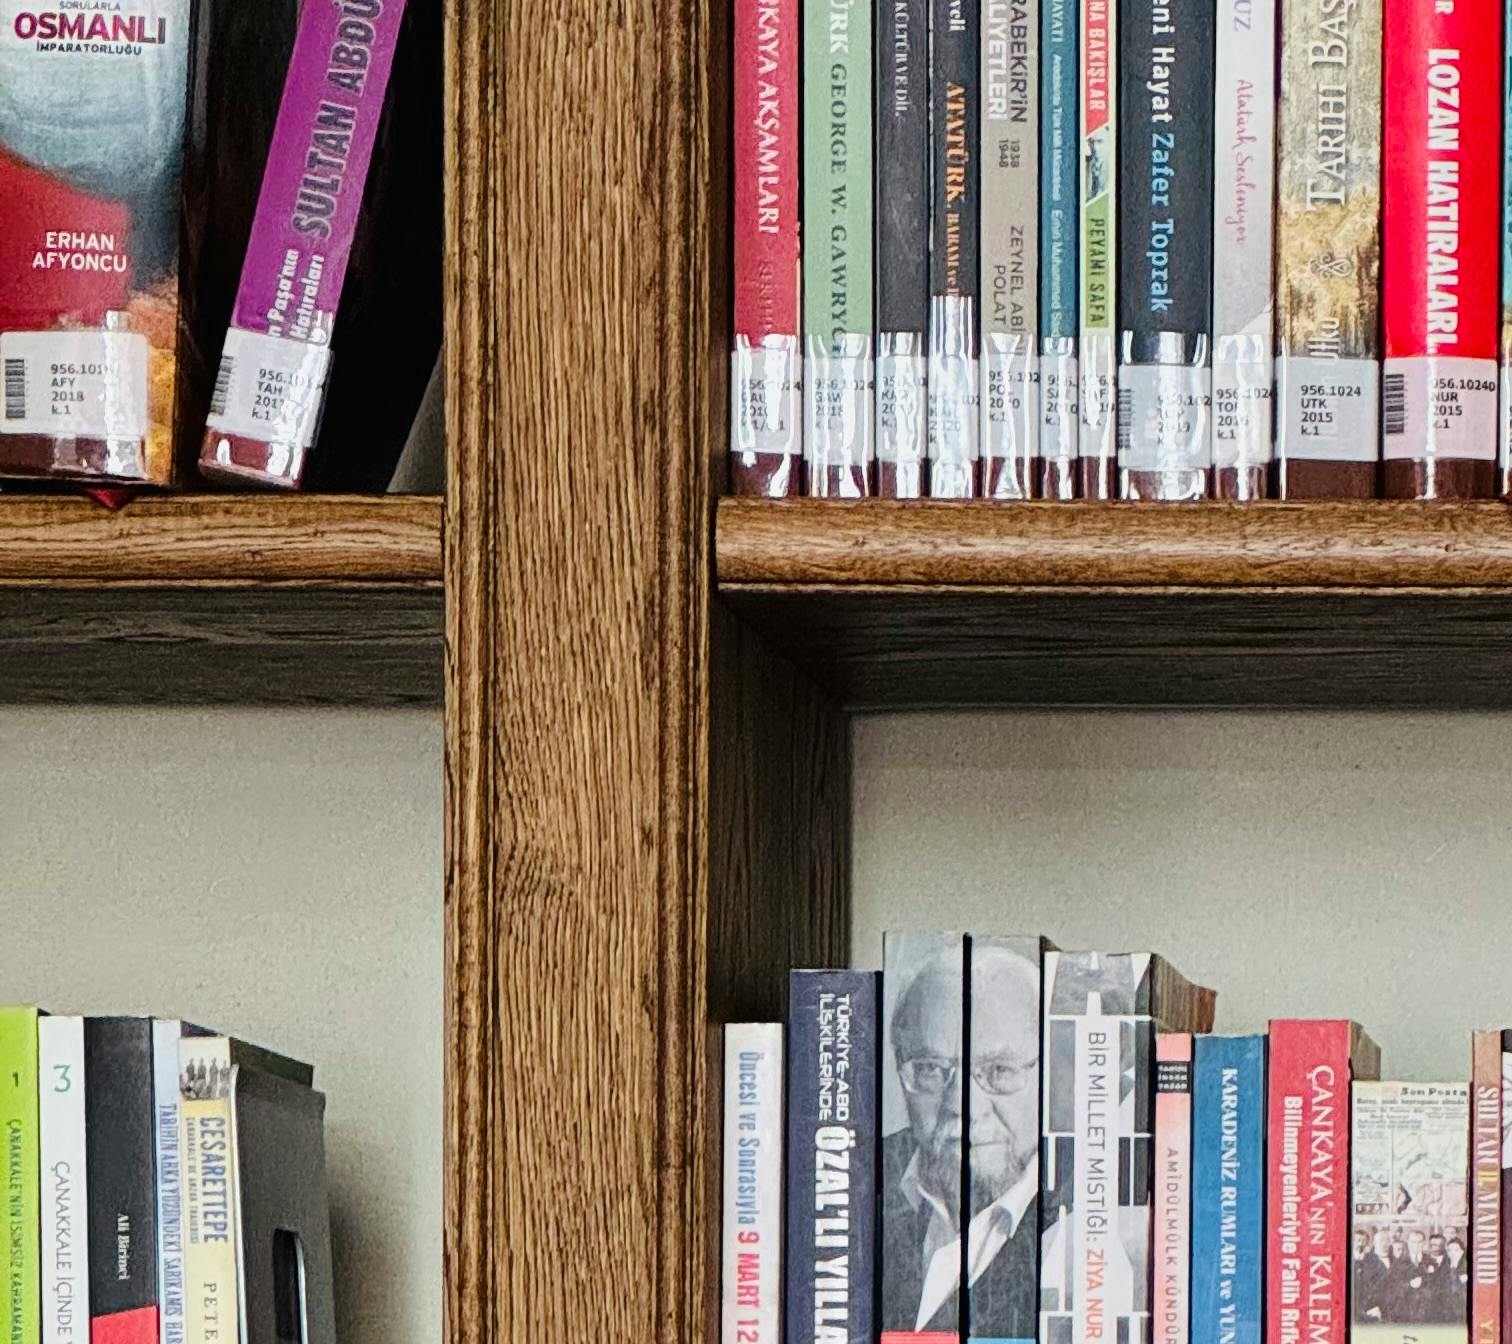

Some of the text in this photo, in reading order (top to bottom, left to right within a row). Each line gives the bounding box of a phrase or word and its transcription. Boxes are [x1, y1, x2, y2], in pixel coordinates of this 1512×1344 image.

[14, 12, 166, 44] OSMANLI
[1086, 28, 1106, 110] BAKIŞLAR
[830, 63, 848, 173] GEORGE
[1428, 49, 1460, 149] LOZAN
[293, 101, 357, 240] SULTAN
[754, 83, 780, 233] AKŞAMLARI
[1145, 47, 1176, 312] Hayat Zafer Toprak
[32, 252, 127, 273] AFYONCU
[45, 231, 114, 251] ERHAN
[1009, 225, 1024, 297] ZEYNEL
[993, 264, 1007, 324] POLAT
[1301, 399, 1327, 409] UTK
[1301, 412, 1332, 423] 2015
[736, 1051, 760, 1107] Öncesi
[815, 994, 836, 1121] İLİŞKİLERİNDE
[836, 994, 853, 1121] TÜRKİYE-ABD
[1086, 1033, 1109, 1068] BİR
[1086, 1075, 1109, 1148] MİLLET
[1220, 1067, 1240, 1181] KARADENİZ
[52, 1161, 72, 1268] ÇANAKKALE
[200, 1116, 228, 1243] CESARETTEPE
[735, 1137, 760, 1225] Sonrasıyla
[815, 1127, 854, 1248] ÖZAL'LI
[1218, 1186, 1238, 1276] RUMLARI
[738, 1252, 760, 1308] MART
[1085, 1298, 1104, 1338] NUR
[738, 1317, 760, 1343] 12
